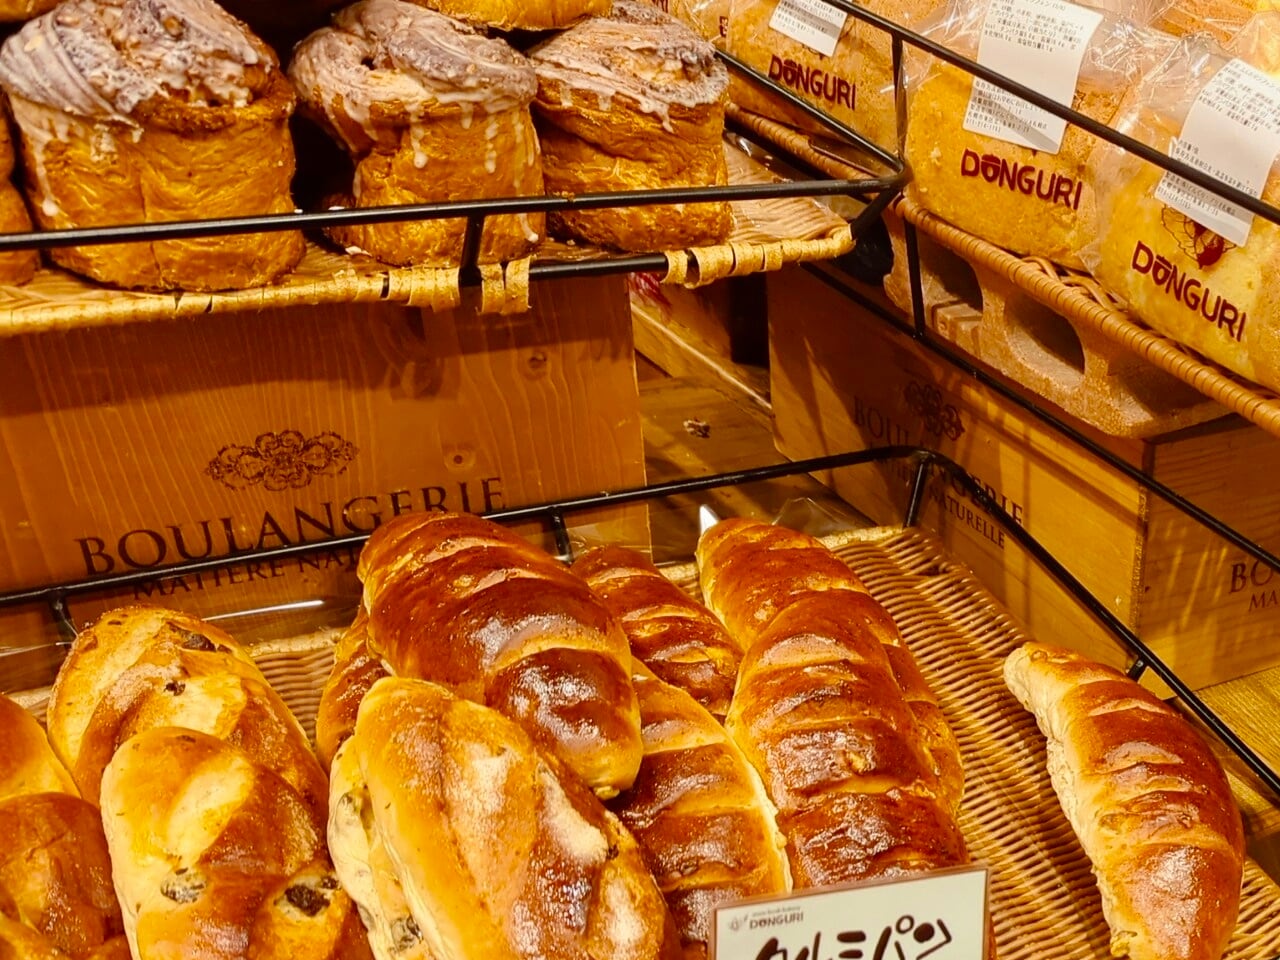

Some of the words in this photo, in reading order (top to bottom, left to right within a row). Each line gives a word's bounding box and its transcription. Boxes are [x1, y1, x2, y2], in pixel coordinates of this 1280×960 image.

[768, 54, 856, 111] DONGURI
[961, 148, 1082, 210] DONGURI
[1131, 240, 1246, 342] DONGURI
[750, 912, 804, 929] DONGURI
